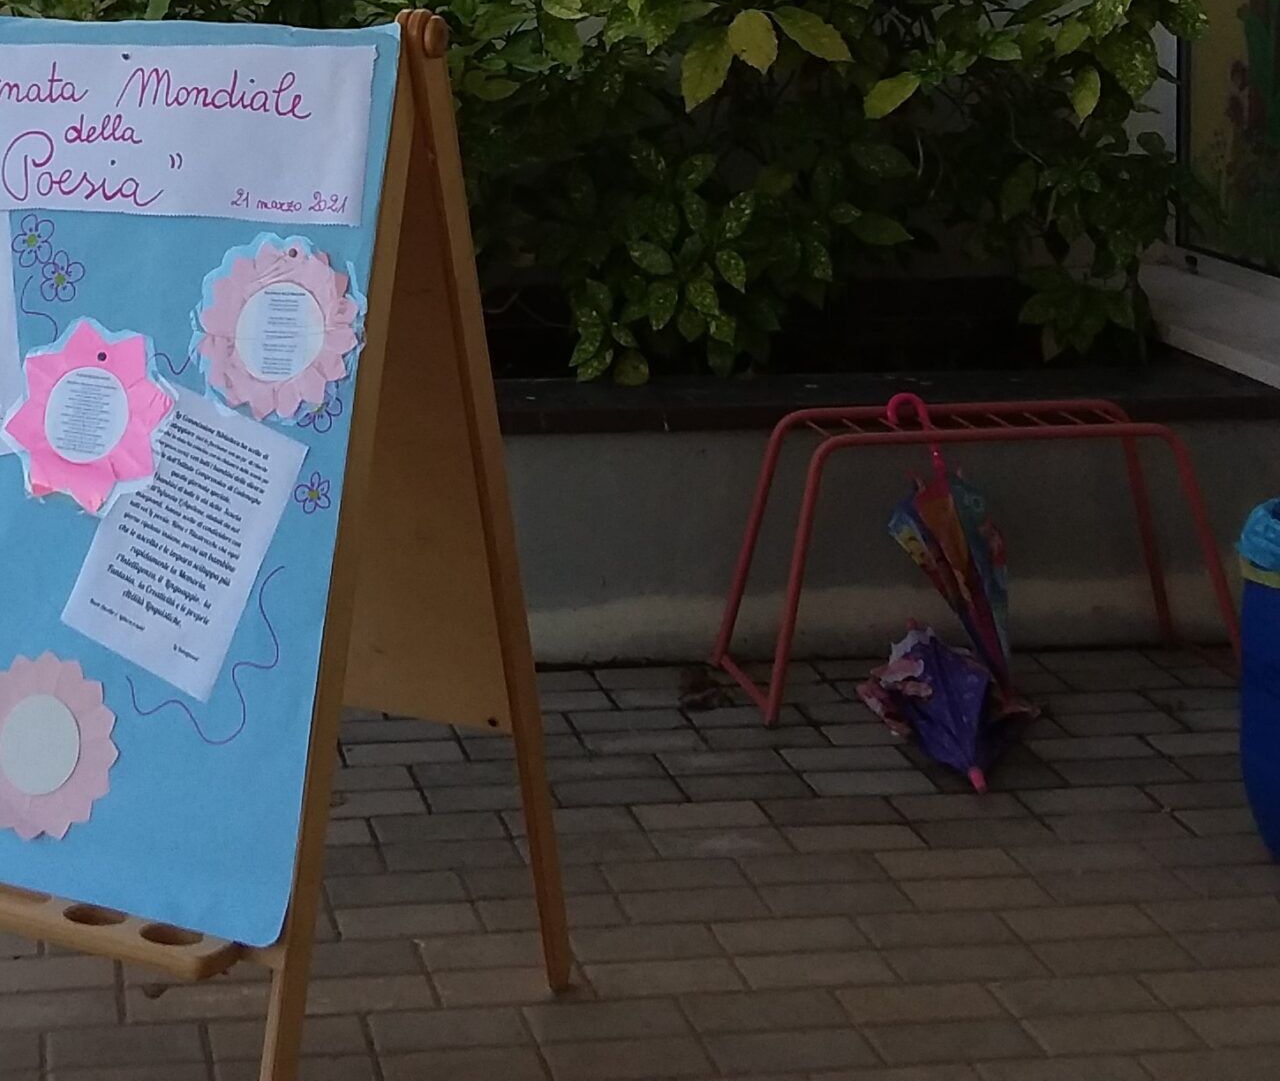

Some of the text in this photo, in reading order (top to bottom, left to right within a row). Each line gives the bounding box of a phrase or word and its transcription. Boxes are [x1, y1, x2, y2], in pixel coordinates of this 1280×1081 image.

[115, 64, 312, 120] Mondiale
[64, 113, 143, 145] della
[231, 188, 347, 214] 21 marzo 2021
